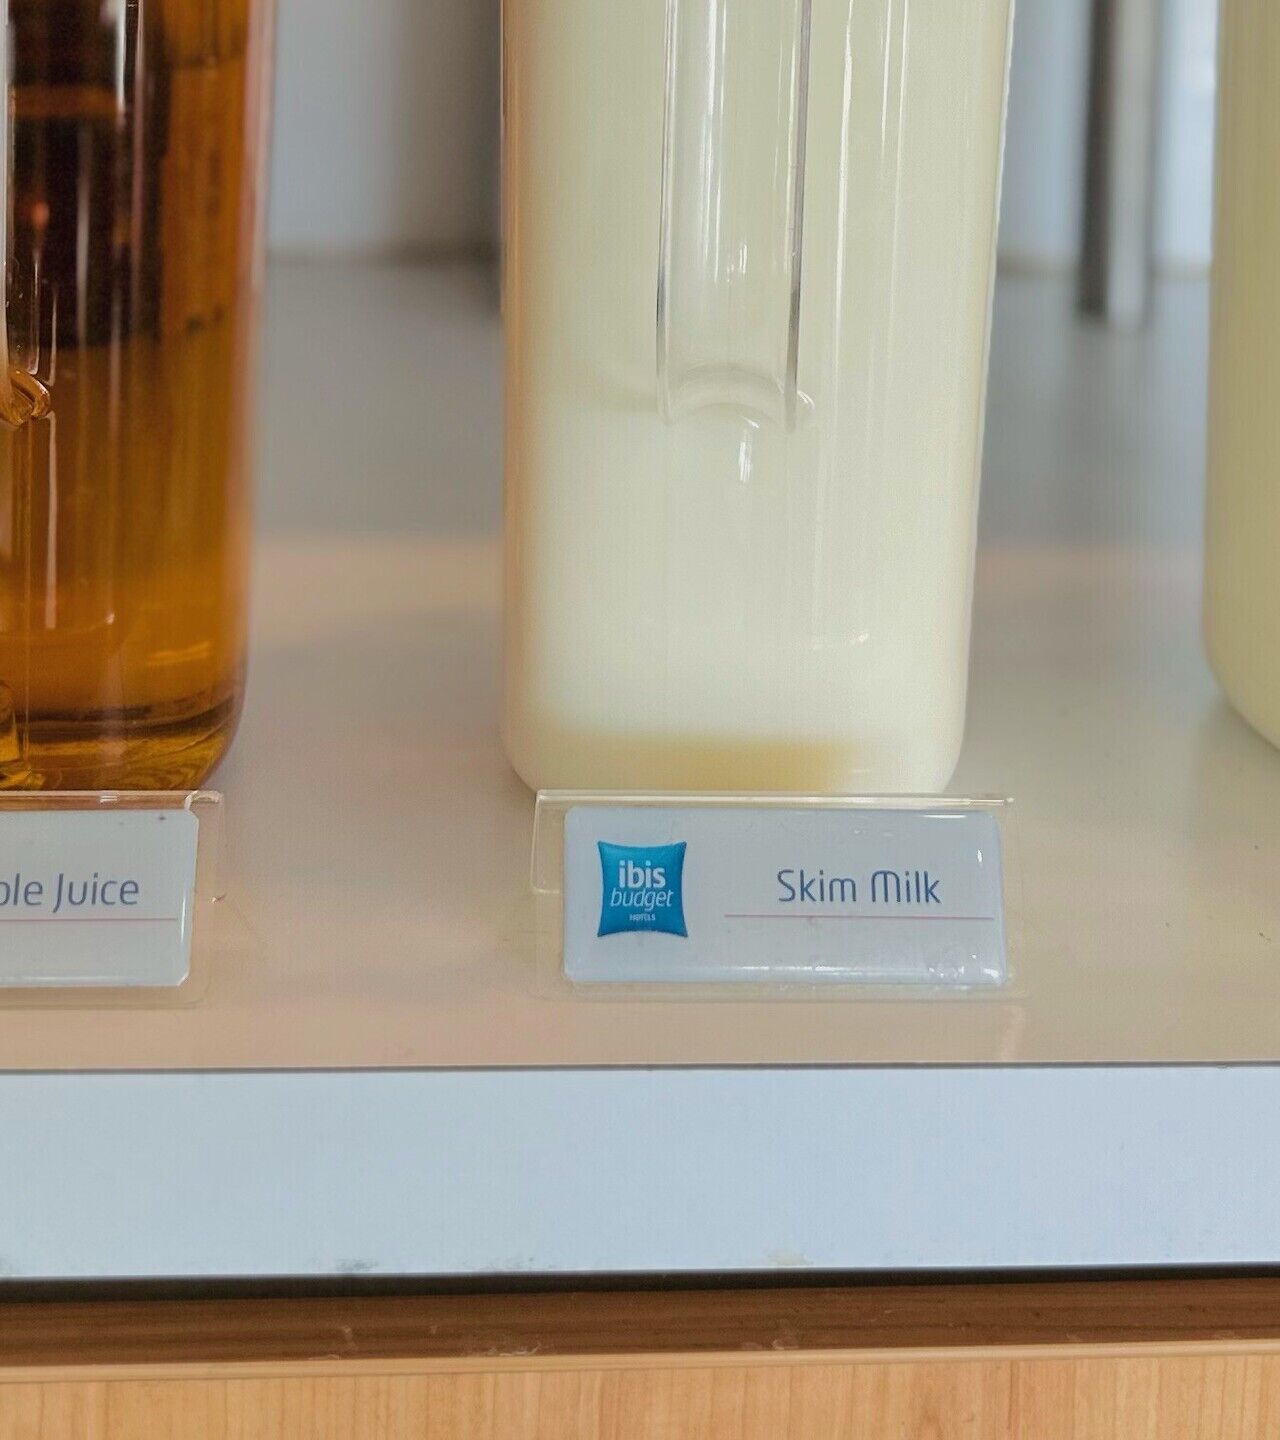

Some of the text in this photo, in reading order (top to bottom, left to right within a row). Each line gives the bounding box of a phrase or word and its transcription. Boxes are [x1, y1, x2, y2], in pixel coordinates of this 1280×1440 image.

[618, 859, 666, 889] ibis
[776, 868, 942, 904] Skim Milk
[52, 871, 140, 913] Juice
[609, 887, 674, 912] budget
